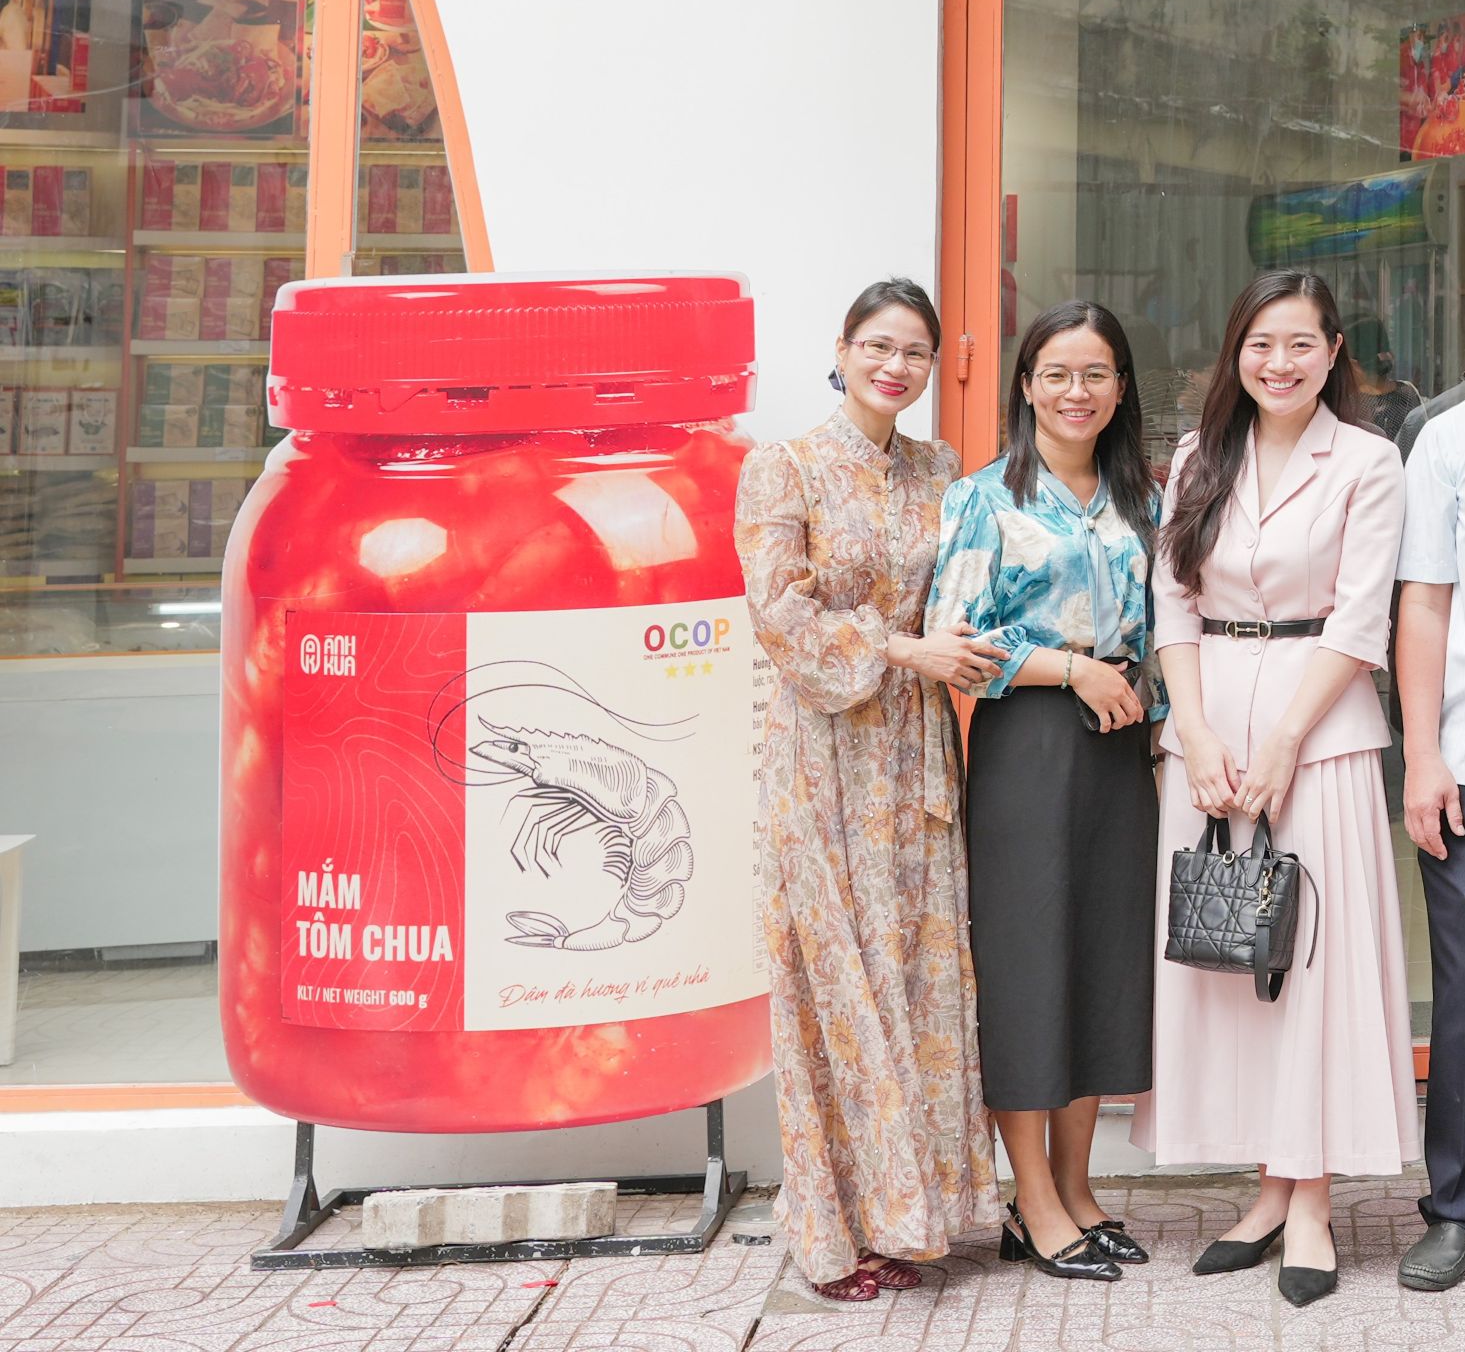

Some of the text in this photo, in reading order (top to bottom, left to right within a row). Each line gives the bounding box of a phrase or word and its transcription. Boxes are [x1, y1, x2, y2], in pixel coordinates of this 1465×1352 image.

[644, 618, 731, 652] OCOP
[324, 655, 356, 676] KUA
[297, 858, 361, 910] MẮM
[296, 911, 454, 962] TÔM CHUA
[297, 985, 428, 1009] KLT / NET WEIGHT 600 g
